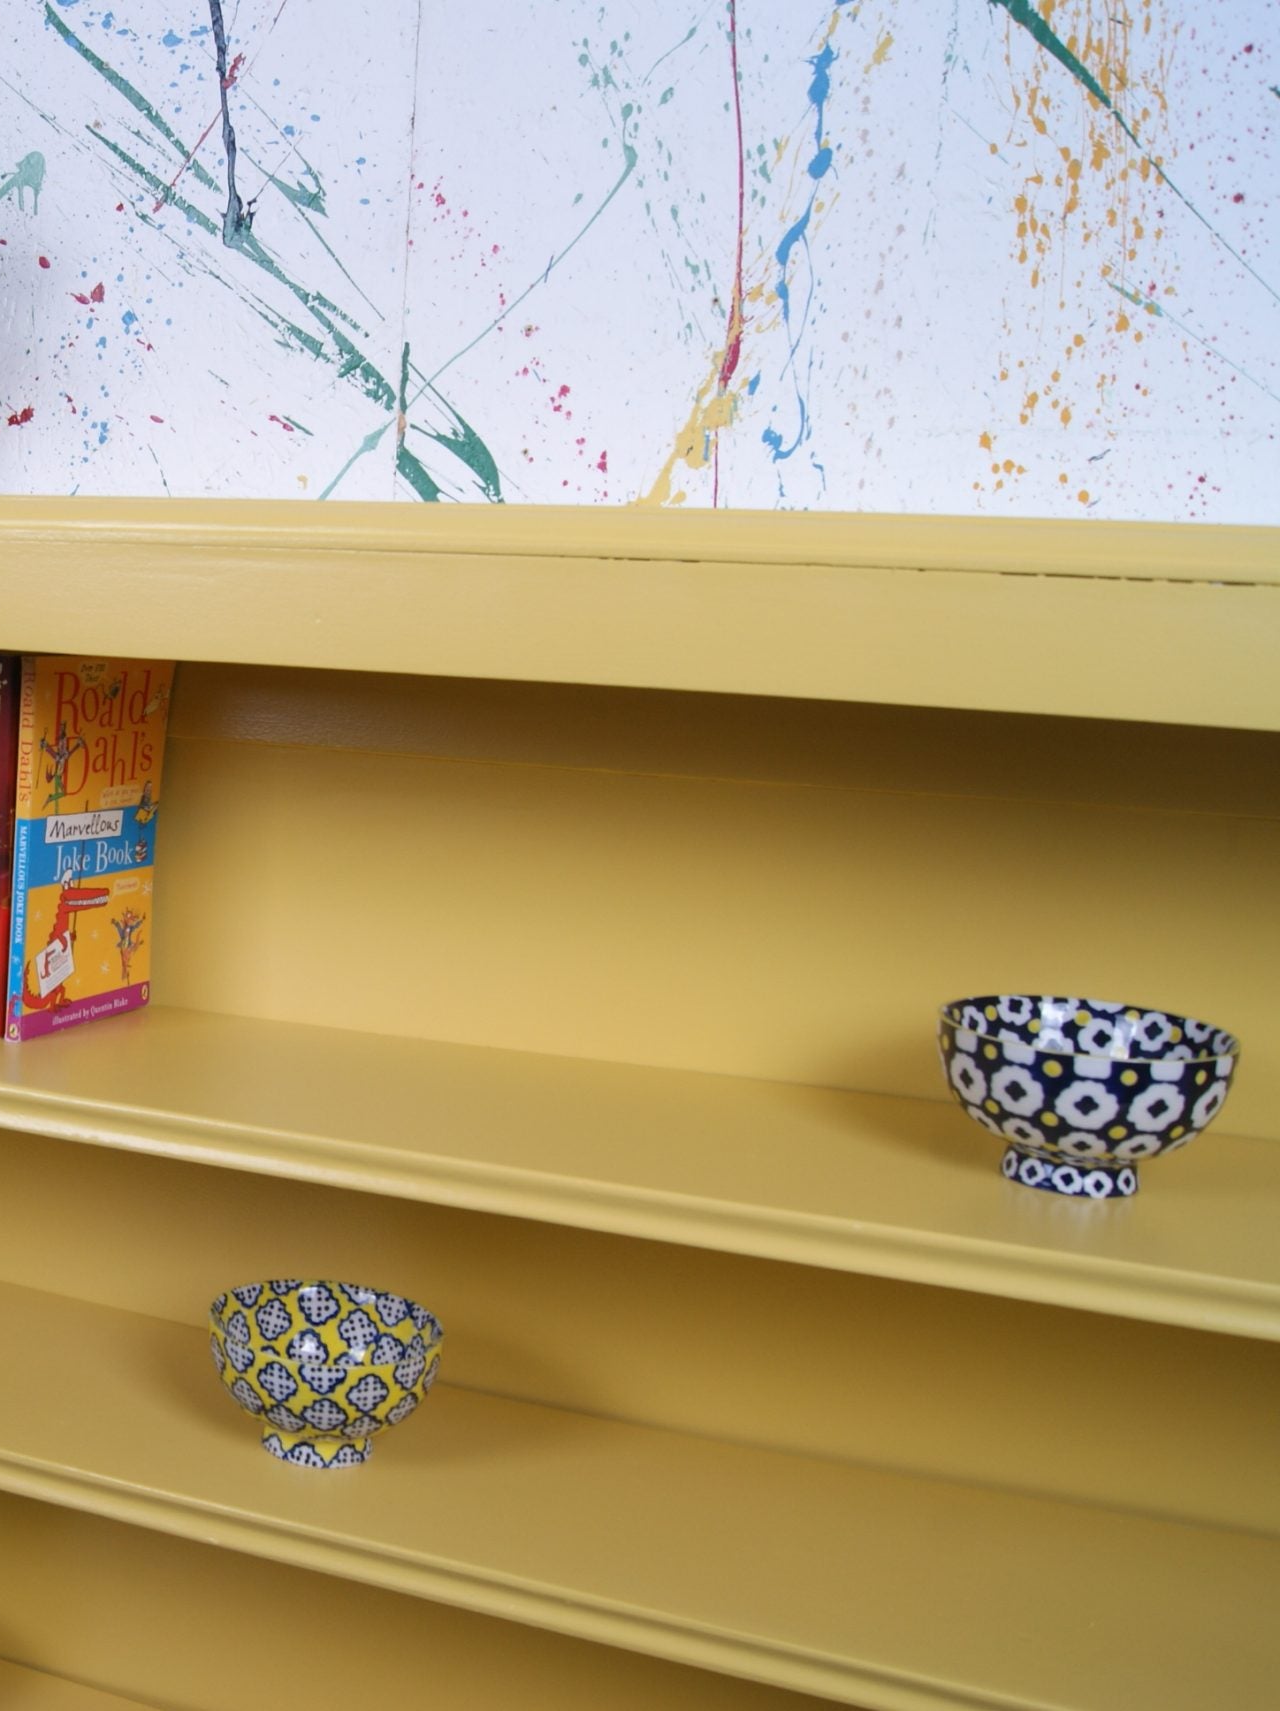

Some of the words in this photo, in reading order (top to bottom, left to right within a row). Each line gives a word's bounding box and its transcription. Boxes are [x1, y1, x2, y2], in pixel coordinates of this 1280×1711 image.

[21, 671, 36, 729] Roald
[49, 670, 152, 748] Roald
[19, 740, 34, 802] Dahl's
[60, 731, 153, 796] Dahl's
[49, 813, 121, 838] Marvellous
[15, 826, 27, 889] MARVELLOUS
[53, 845, 91, 881] Joke
[95, 840, 133, 873] Book
[15, 890, 26, 914] JOKE
[14, 916, 24, 944] BOOK
[52, 1008, 82, 1026] illustrated
[83, 1008, 90, 1019] by
[90, 1003, 113, 1017] Quentin
[113, 997, 129, 1009] Blake
